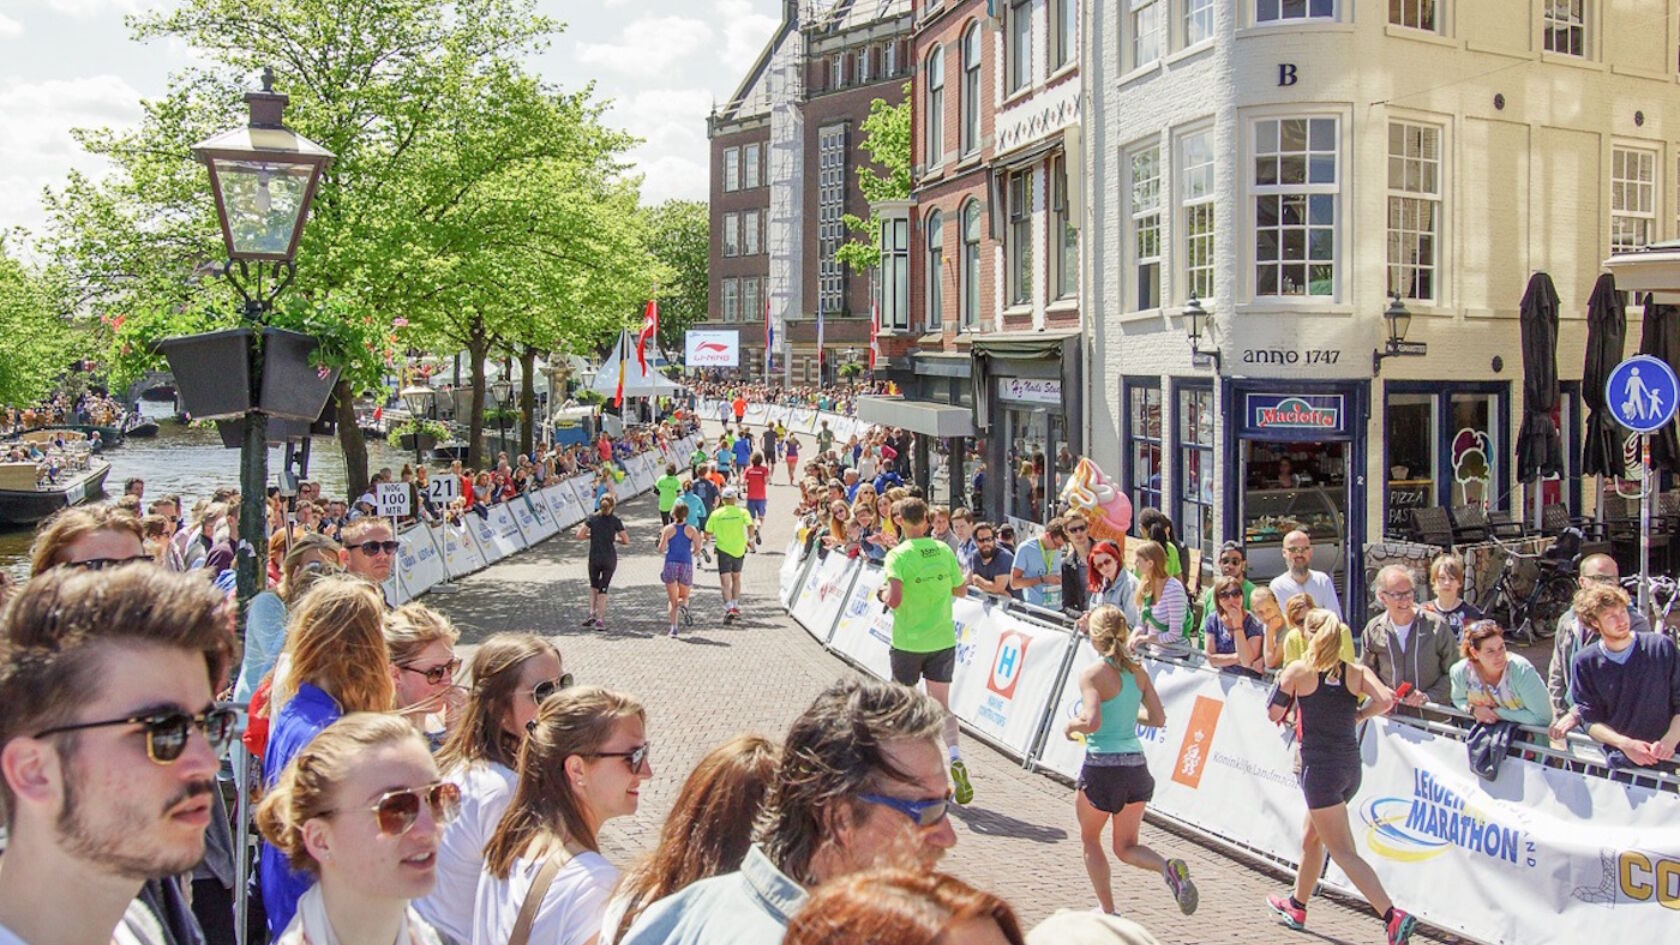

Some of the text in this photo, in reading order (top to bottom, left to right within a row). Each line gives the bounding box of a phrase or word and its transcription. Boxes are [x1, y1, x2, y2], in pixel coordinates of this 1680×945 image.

[1278, 63, 1298, 87] B
[1243, 348, 1340, 366] anno 1747
[385, 484, 401, 492] NOG
[432, 479, 452, 497] 21
[382, 493, 406, 505] 100
[1390, 490, 1423, 505] PIZZA
[385, 506, 402, 514] MTR
[1405, 798, 1519, 864] MARATHON
